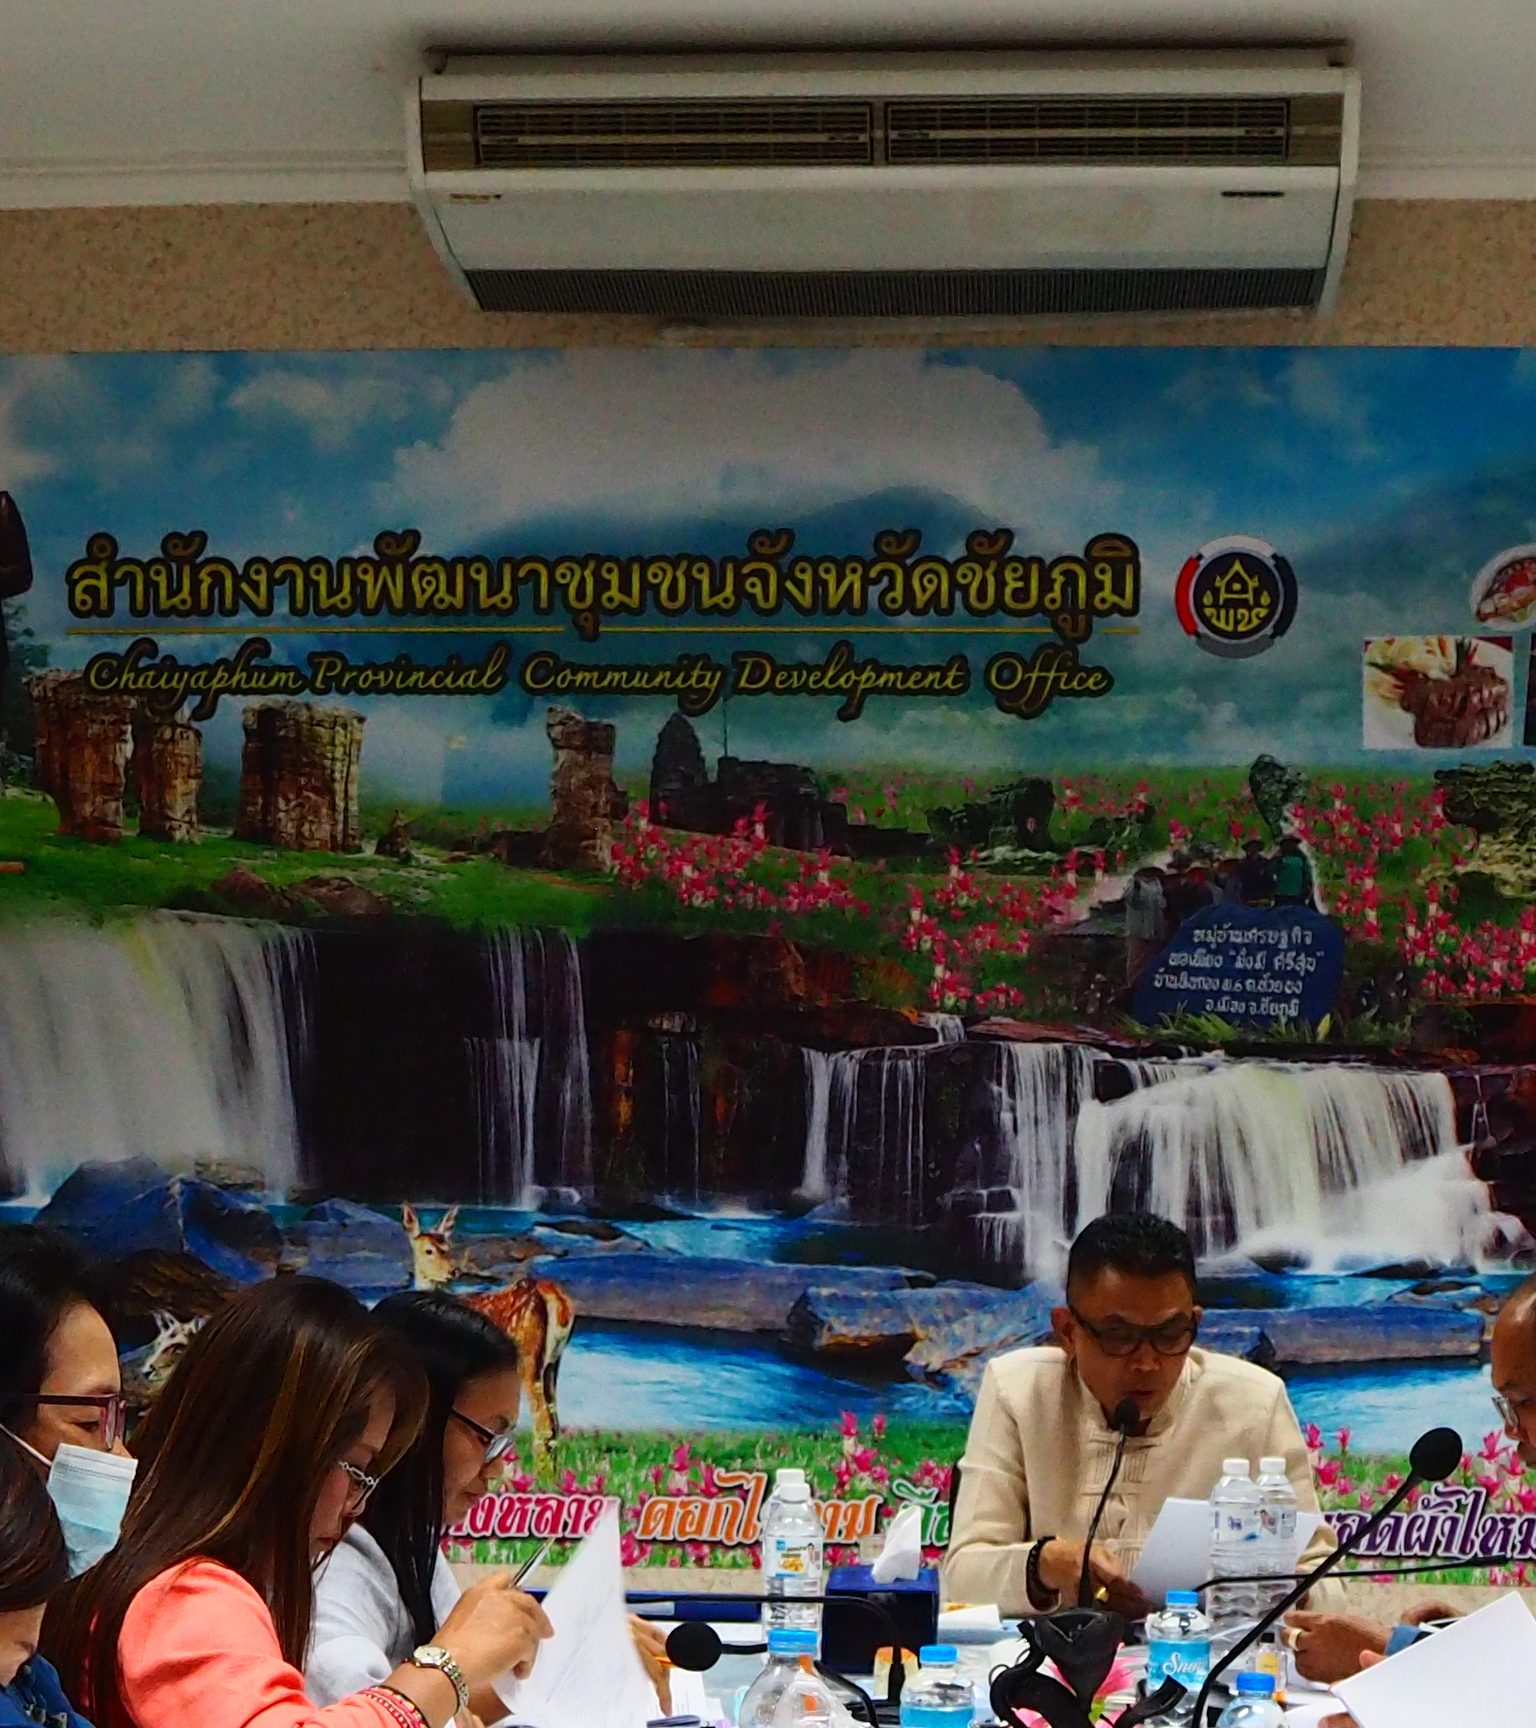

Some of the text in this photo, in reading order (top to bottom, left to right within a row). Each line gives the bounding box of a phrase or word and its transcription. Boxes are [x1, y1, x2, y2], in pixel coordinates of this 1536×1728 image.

[68, 530, 1138, 642] สำนักงานพัฒนาชุมชนจังหวัดชัยภูมิ
[88, 638, 1110, 721] Chaiyaphum Provincial Community Development Office
